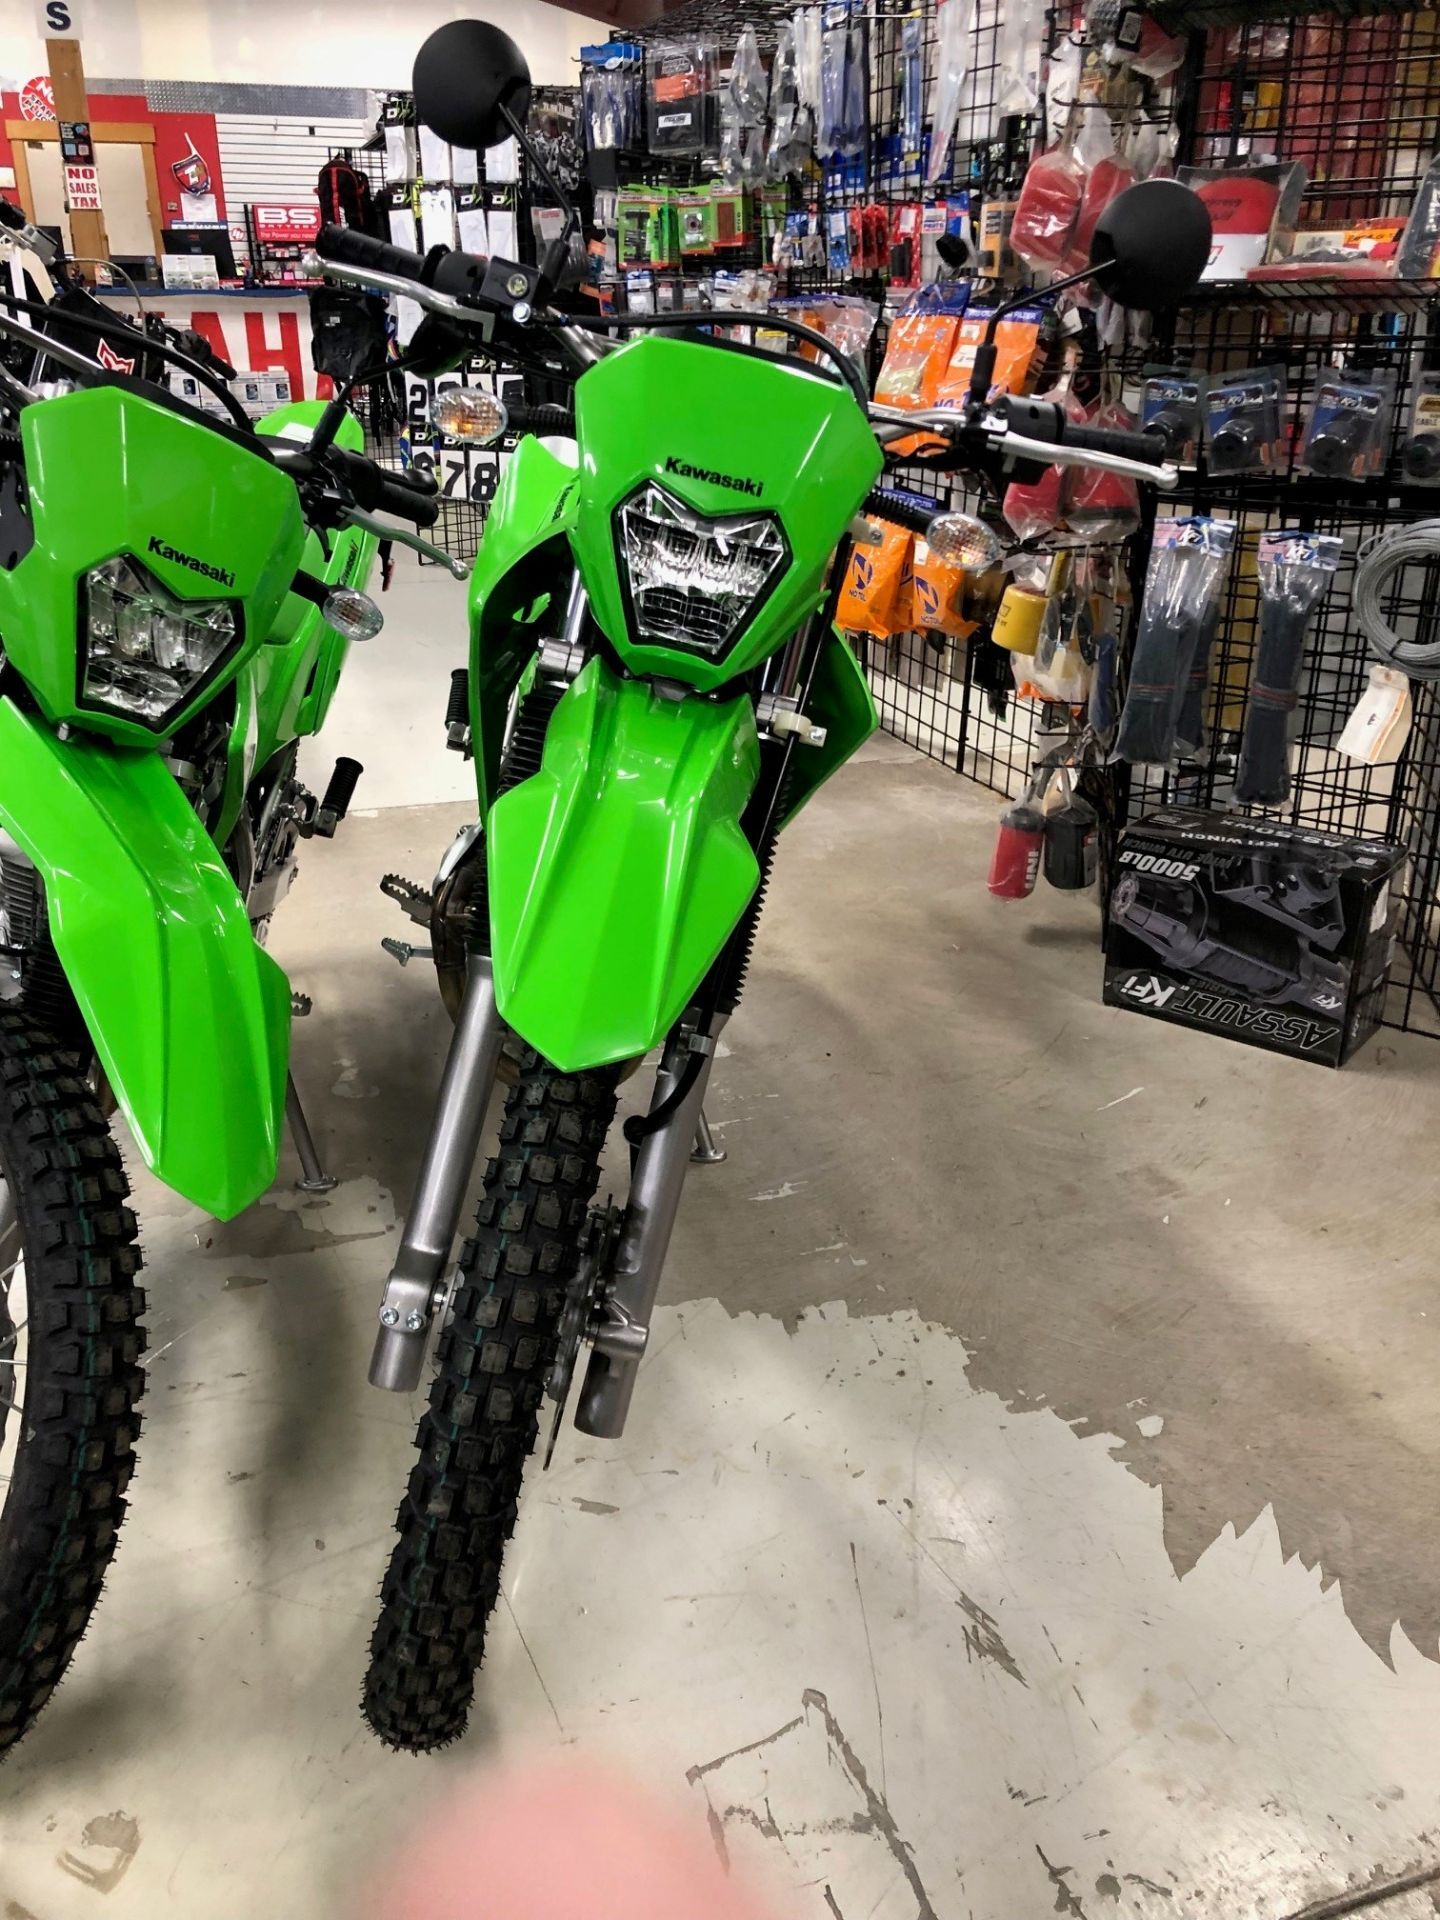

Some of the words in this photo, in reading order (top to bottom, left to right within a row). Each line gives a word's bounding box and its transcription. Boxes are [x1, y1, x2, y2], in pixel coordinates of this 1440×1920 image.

[46, 1, 71, 31] S
[67, 168, 94, 179] NO
[69, 183, 97, 194] SALES
[71, 197, 98, 208] TAX
[257, 207, 317, 224] BS
[665, 456, 764, 498] Kawasaki
[148, 535, 236, 588] Kawasaki
[1180, 831, 1242, 846] WINCH
[1118, 850, 1201, 882] 5000LB
[1171, 991, 1340, 1050] ASSAULT
